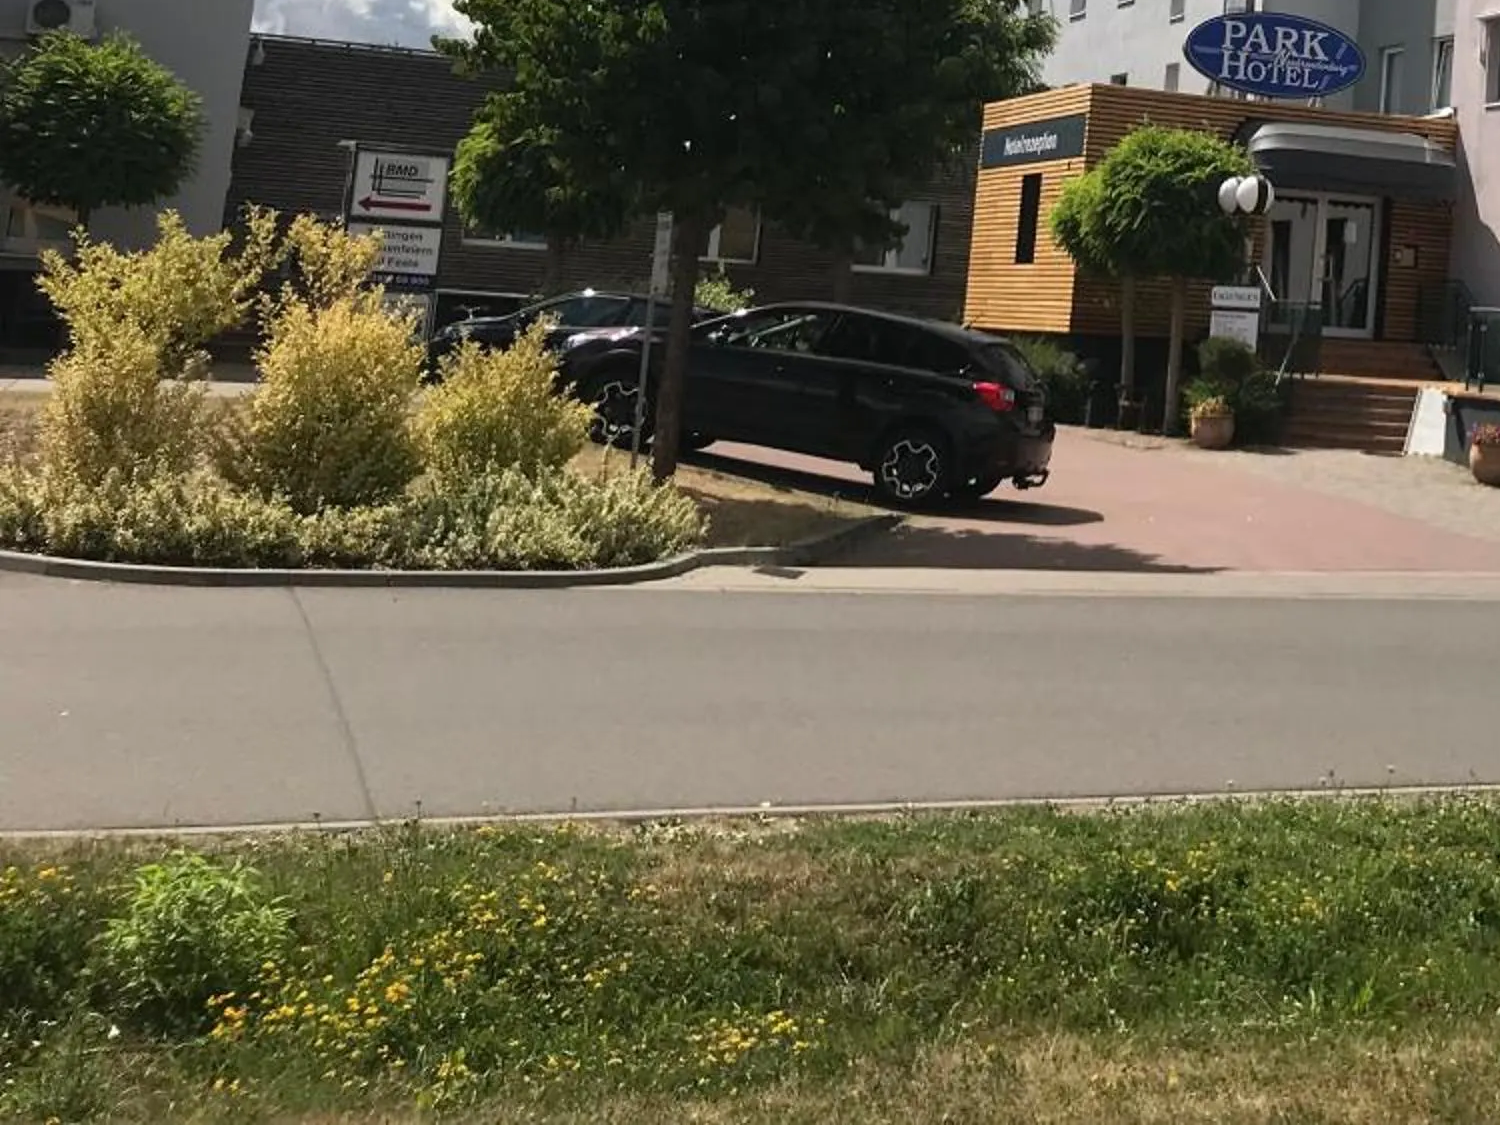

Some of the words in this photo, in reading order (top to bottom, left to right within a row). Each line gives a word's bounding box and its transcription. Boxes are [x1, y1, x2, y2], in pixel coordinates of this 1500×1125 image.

[1222, 20, 1329, 61] PARK
[1219, 50, 1319, 89] HOTEL
[386, 162, 419, 178] RMD
